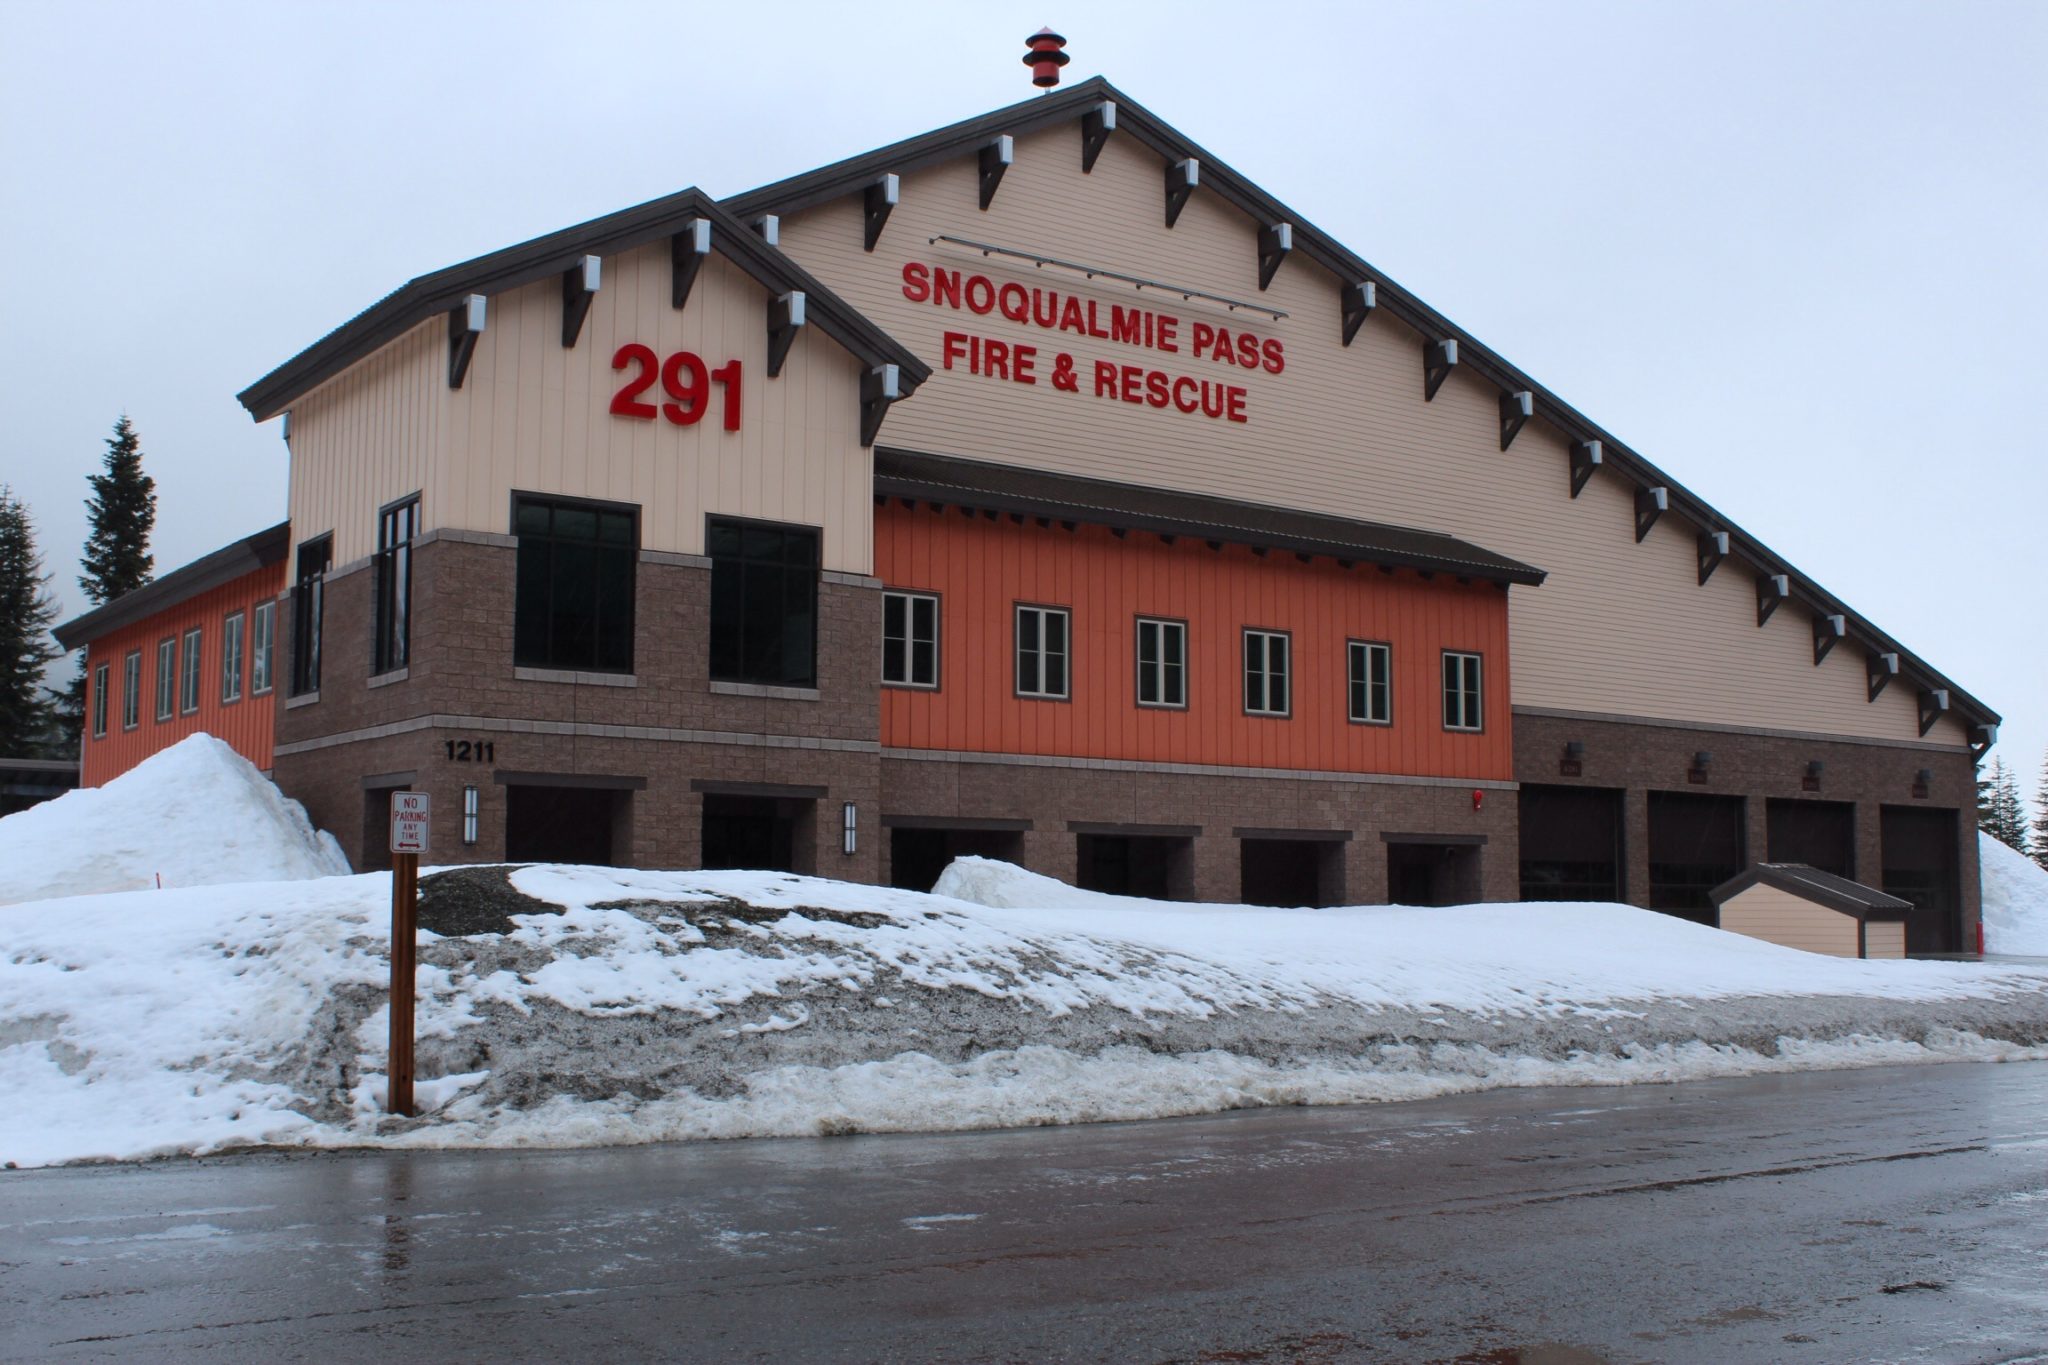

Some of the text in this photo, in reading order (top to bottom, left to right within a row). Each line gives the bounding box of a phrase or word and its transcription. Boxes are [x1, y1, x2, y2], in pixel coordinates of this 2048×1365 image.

[902, 262, 1285, 374] SNOQUALMIE PASS
[943, 331, 1249, 423] FIRE & RESCUE
[609, 342, 742, 433] 291
[445, 739, 494, 763] 1211
[403, 798, 418, 809] NO
[394, 810, 427, 822] PARKING
[401, 831, 419, 840] TIME
[403, 823, 418, 831] ANY
